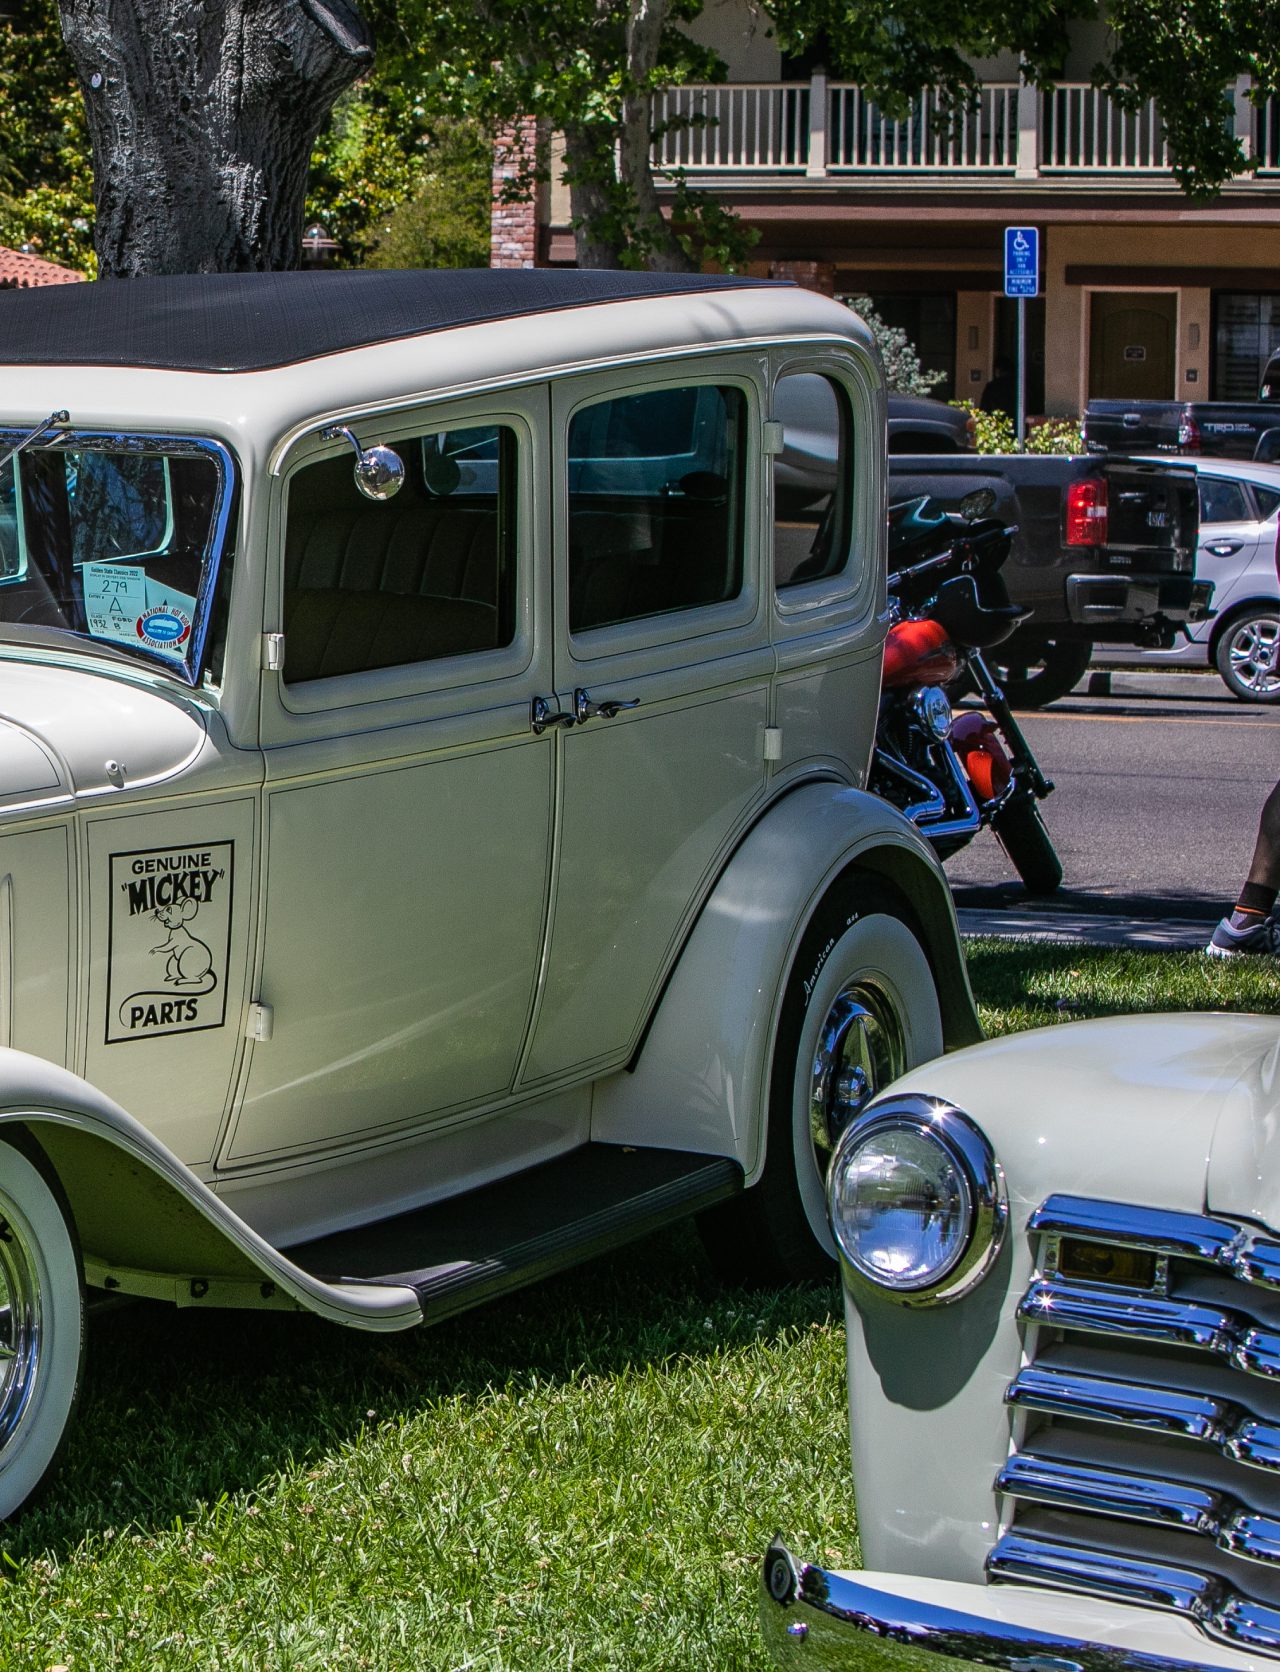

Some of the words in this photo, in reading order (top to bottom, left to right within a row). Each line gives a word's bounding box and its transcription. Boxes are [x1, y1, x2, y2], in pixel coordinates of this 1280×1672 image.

[1203, 423, 1234, 432] TRD
[113, 568, 129, 576] Classics
[102, 580, 128, 594] 279
[109, 596, 123, 614] A
[90, 618, 107, 629] 1932
[142, 606, 168, 620] NATIONAL
[171, 607, 182, 618] HOT
[179, 614, 190, 627] ROD
[142, 636, 177, 649] ASSOCIATION
[131, 852, 212, 875] GENUINE
[130, 998, 199, 1029] PARTS
